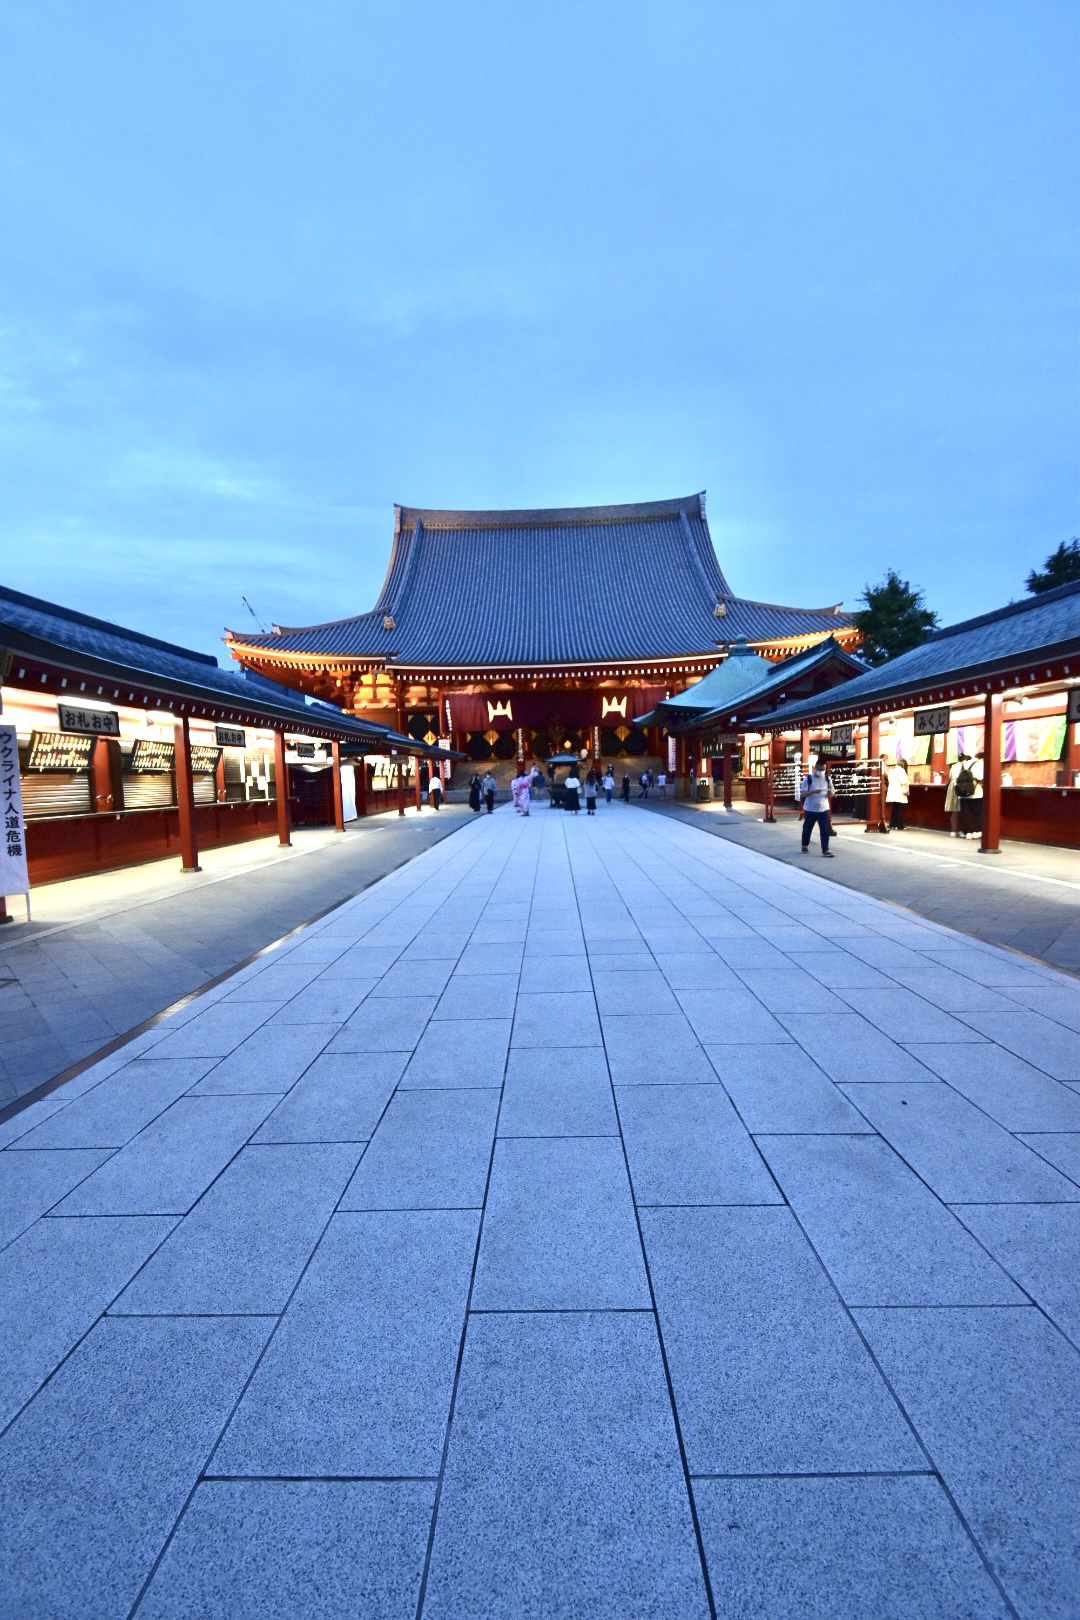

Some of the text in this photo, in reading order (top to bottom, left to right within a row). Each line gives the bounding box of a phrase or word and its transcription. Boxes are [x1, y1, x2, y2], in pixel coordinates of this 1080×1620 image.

[64, 710, 113, 731] お札お守
[918, 713, 946, 730] みくじ
[0, 731, 22, 857] ウクライナ人道危機
